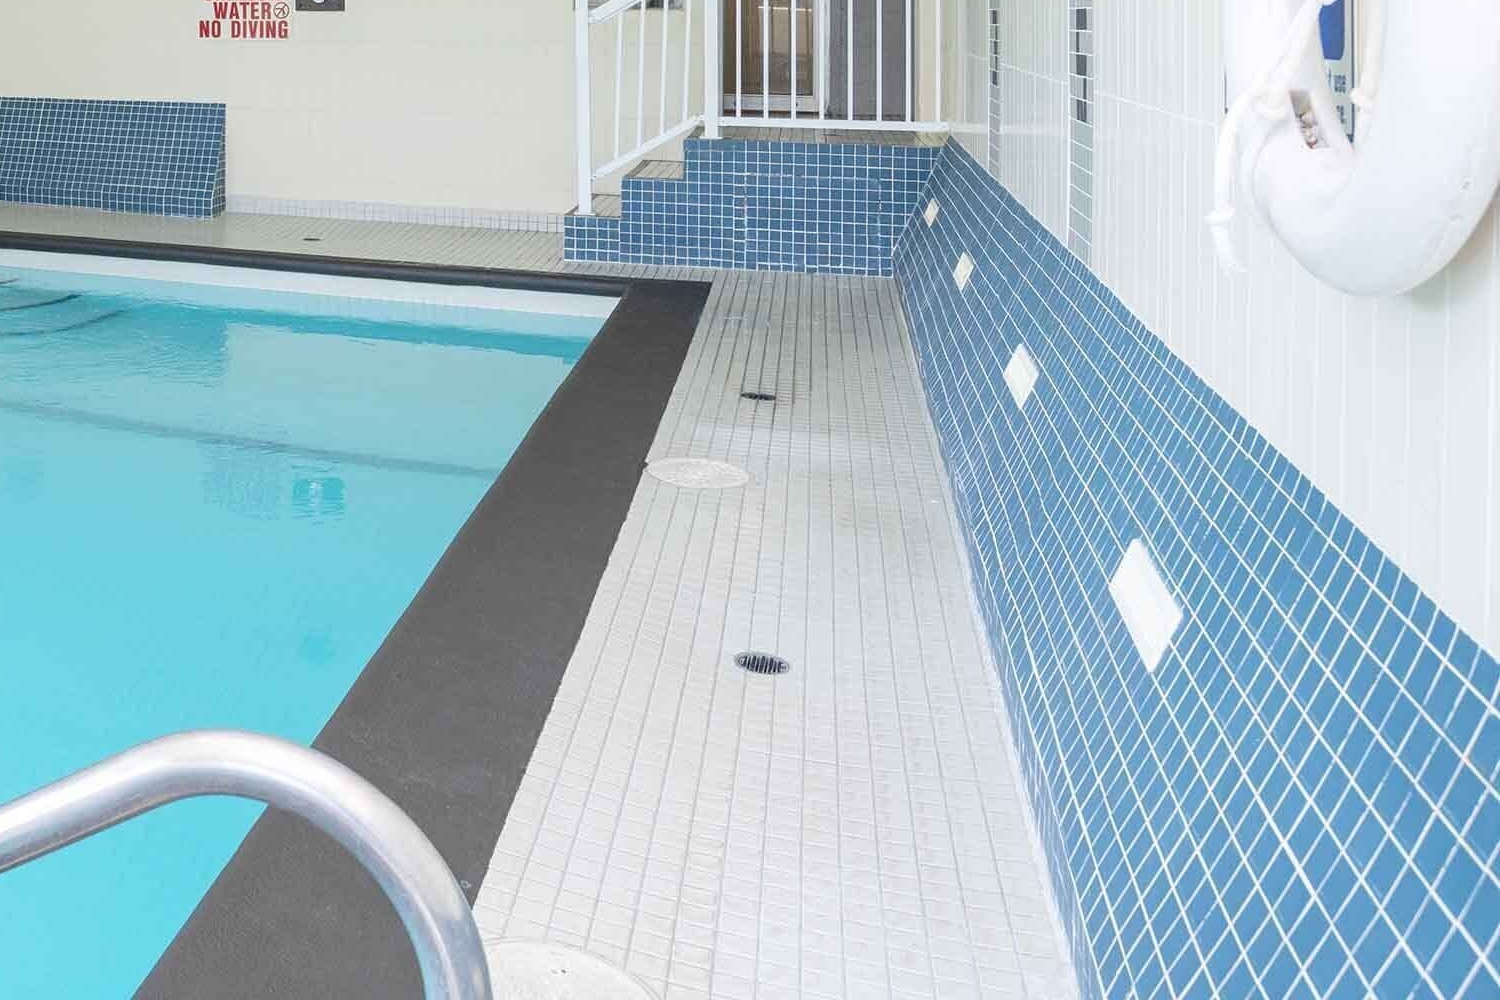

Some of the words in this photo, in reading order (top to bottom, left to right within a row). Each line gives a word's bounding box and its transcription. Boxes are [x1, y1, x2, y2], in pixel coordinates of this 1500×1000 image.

[213, 2, 272, 20] WATER
[198, 20, 222, 38] NO
[231, 20, 289, 39] DIVING
